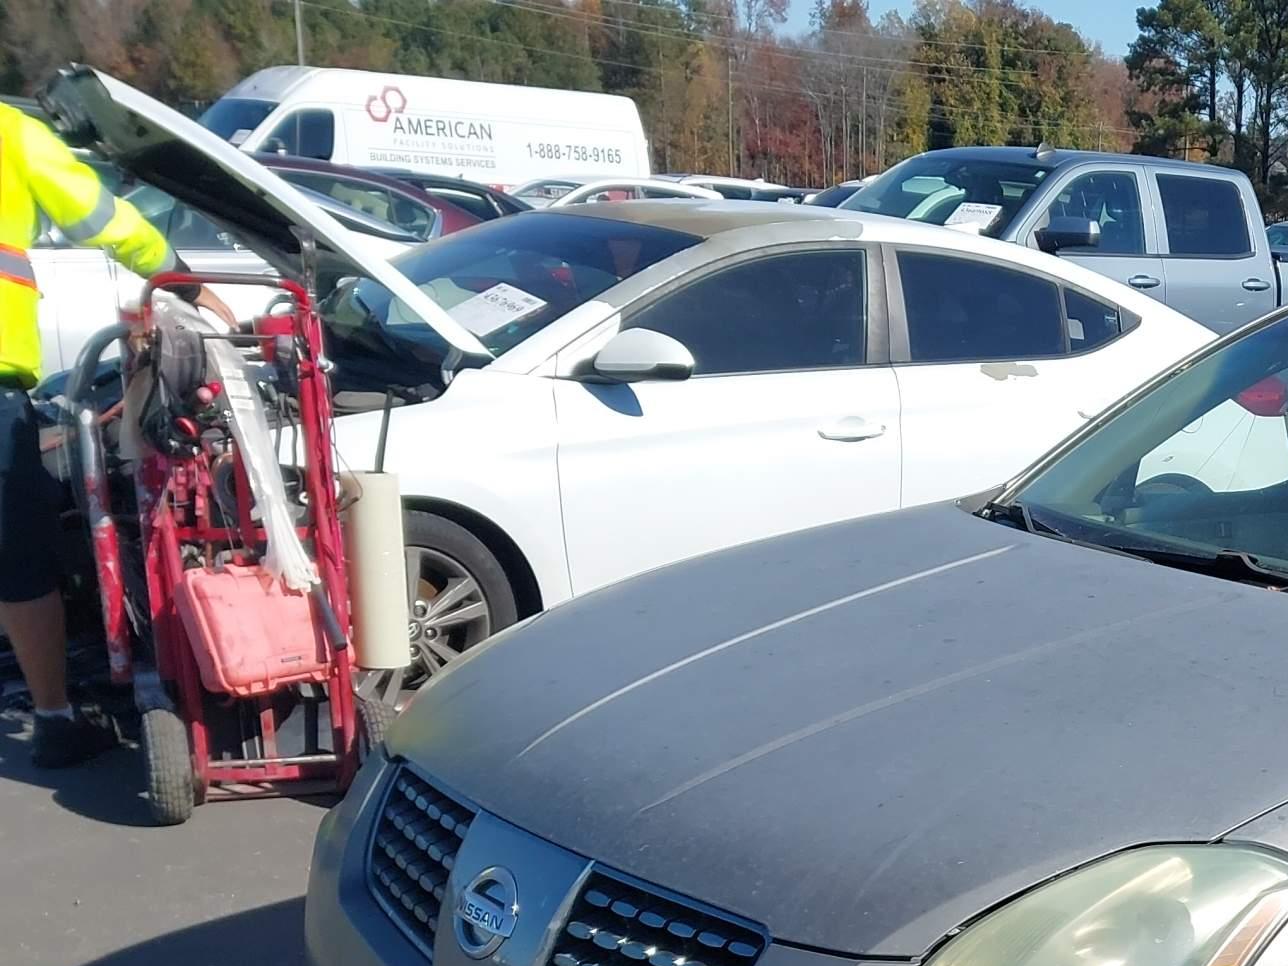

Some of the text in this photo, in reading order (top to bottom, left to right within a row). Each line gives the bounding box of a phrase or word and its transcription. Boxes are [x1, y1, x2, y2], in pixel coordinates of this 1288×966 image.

[393, 116, 493, 140] AMERICAN
[370, 152, 496, 169] BUILDING SYSTEMS SERVICES
[527, 142, 622, 164] 1-888-758-9165
[457, 899, 504, 930] ISSAN
